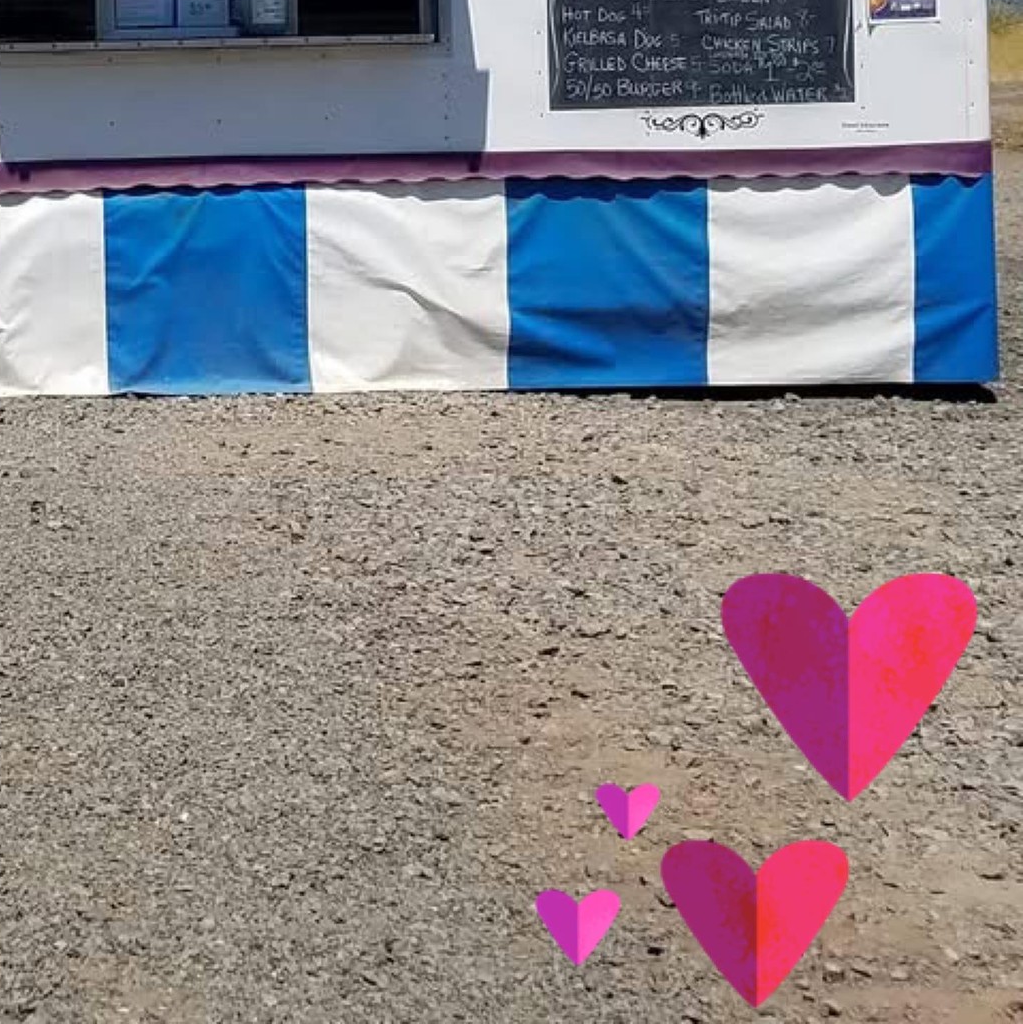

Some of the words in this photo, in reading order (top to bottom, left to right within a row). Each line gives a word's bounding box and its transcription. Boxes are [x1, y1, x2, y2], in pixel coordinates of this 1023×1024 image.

[562, 5, 593, 24] HOT
[597, 6, 628, 23] DOG
[563, 26, 628, 48] KIELBASA
[633, 28, 664, 50] DOG
[700, 33, 763, 53] CHICKEN
[767, 32, 821, 56] STRIPS
[563, 50, 628, 75] GRILLED
[631, 51, 688, 75] CHEESE
[565, 75, 613, 102] 50/50
[616, 77, 684, 98] BURGER
[770, 83, 829, 103] WATER
